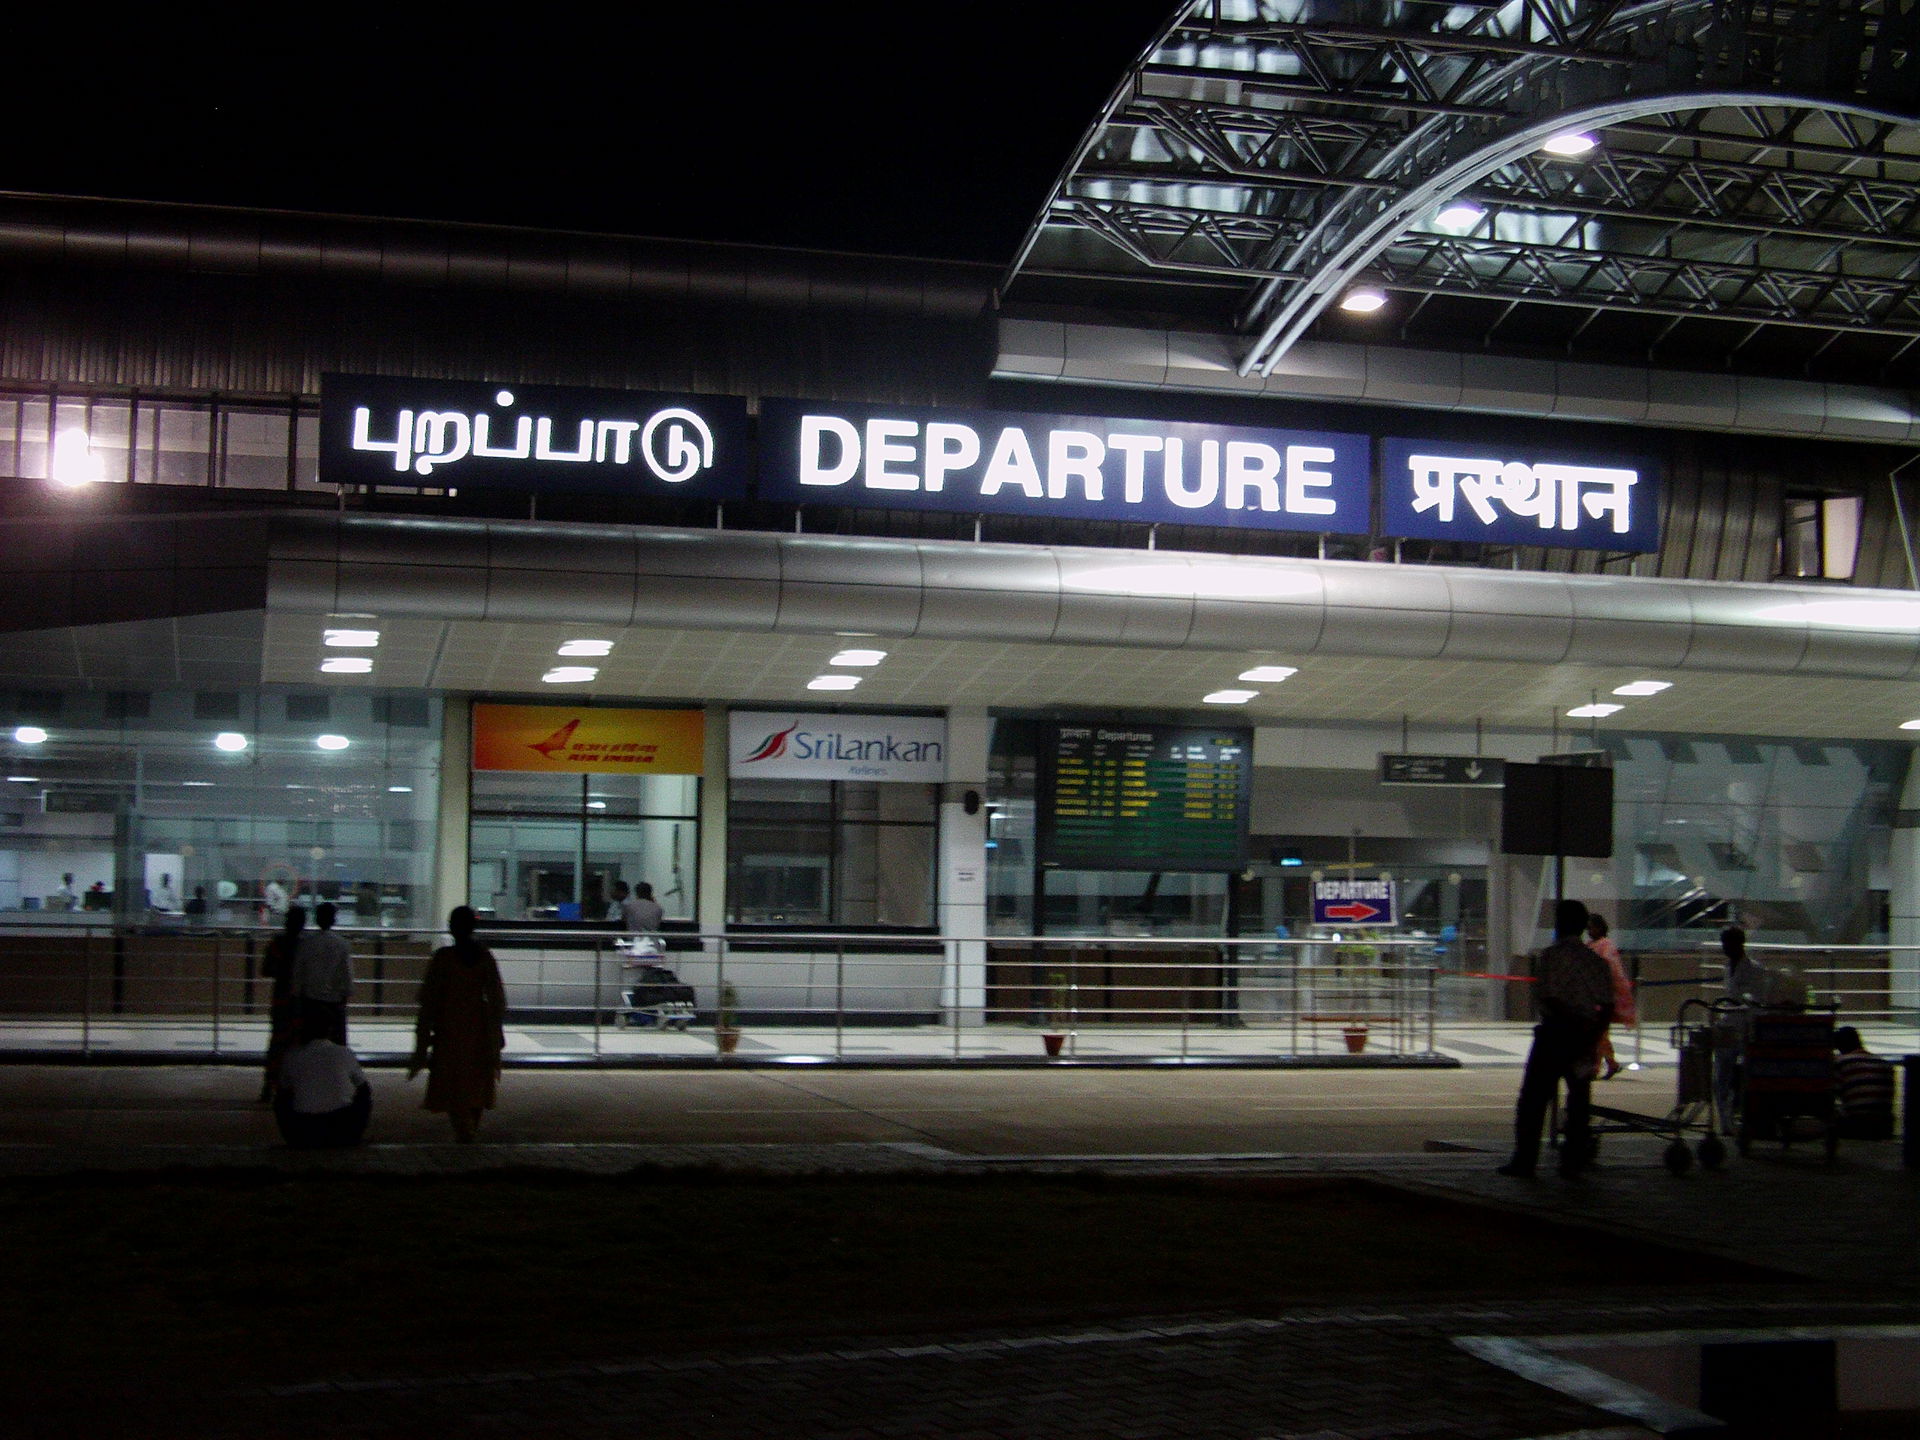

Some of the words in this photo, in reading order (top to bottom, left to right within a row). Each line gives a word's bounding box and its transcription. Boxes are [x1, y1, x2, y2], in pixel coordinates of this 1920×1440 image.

[352, 390, 714, 483] புறப்பாடு
[799, 415, 1337, 515] DEPARTURE
[1408, 454, 1638, 534] प्रस्थान
[793, 731, 942, 761] SriLankan
[1315, 880, 1389, 900] DEPARTURE
